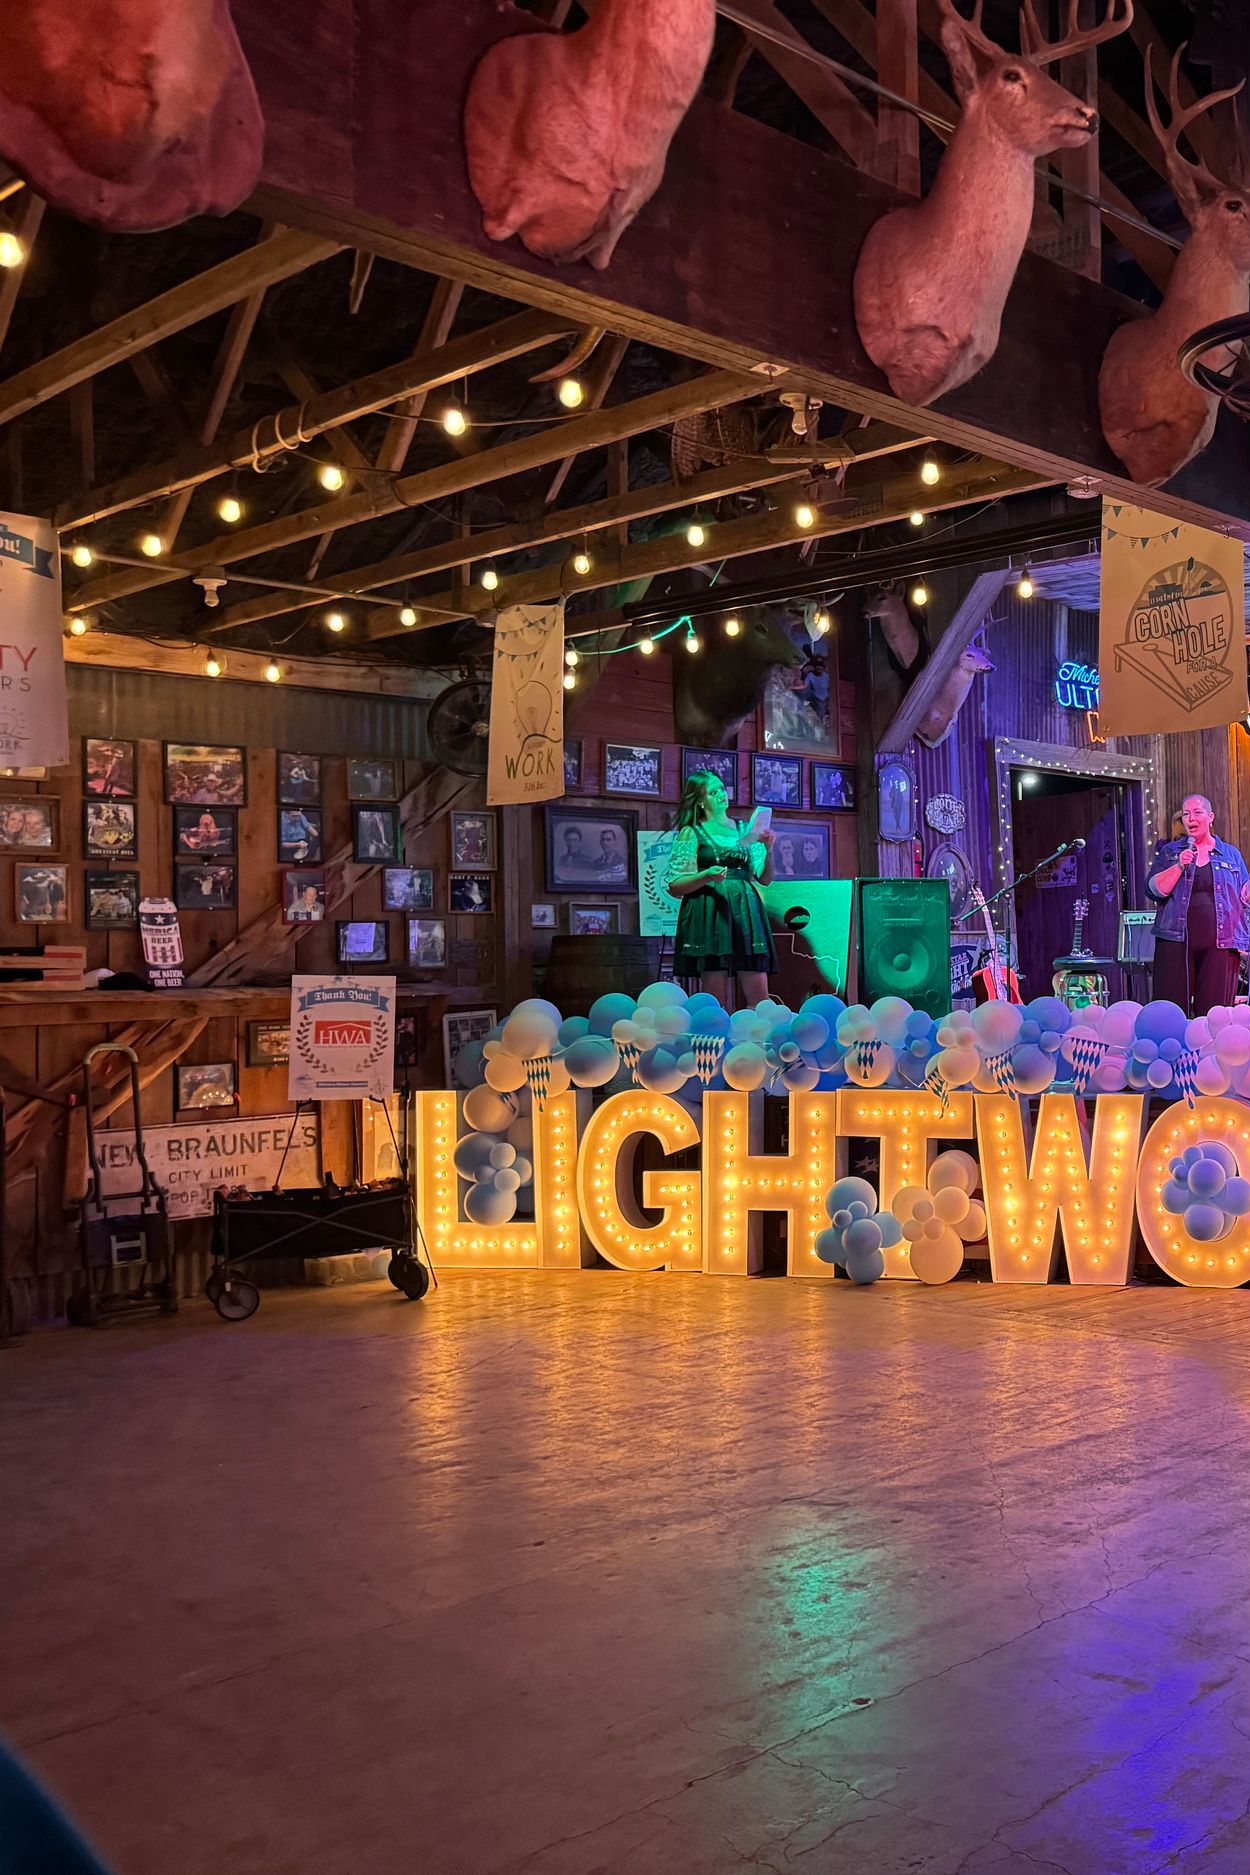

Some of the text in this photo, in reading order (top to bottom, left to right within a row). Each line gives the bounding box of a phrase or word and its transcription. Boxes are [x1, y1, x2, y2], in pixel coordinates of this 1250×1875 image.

[1135, 599, 1191, 642] CORN
[1171, 614, 1227, 665] HOLE
[1186, 659, 1207, 674] FOR
[1186, 671, 1223, 700] CAUSE
[505, 747, 556, 780] WORK
[151, 937, 174, 945] BEER
[149, 970, 162, 979] ONE
[154, 979, 166, 987] ONE
[314, 990, 372, 1001] Thank You!
[319, 1029, 368, 1045] HWA
[167, 1126, 318, 1162] BRAUNFELS
[168, 1164, 249, 1184] CITY LIMIT
